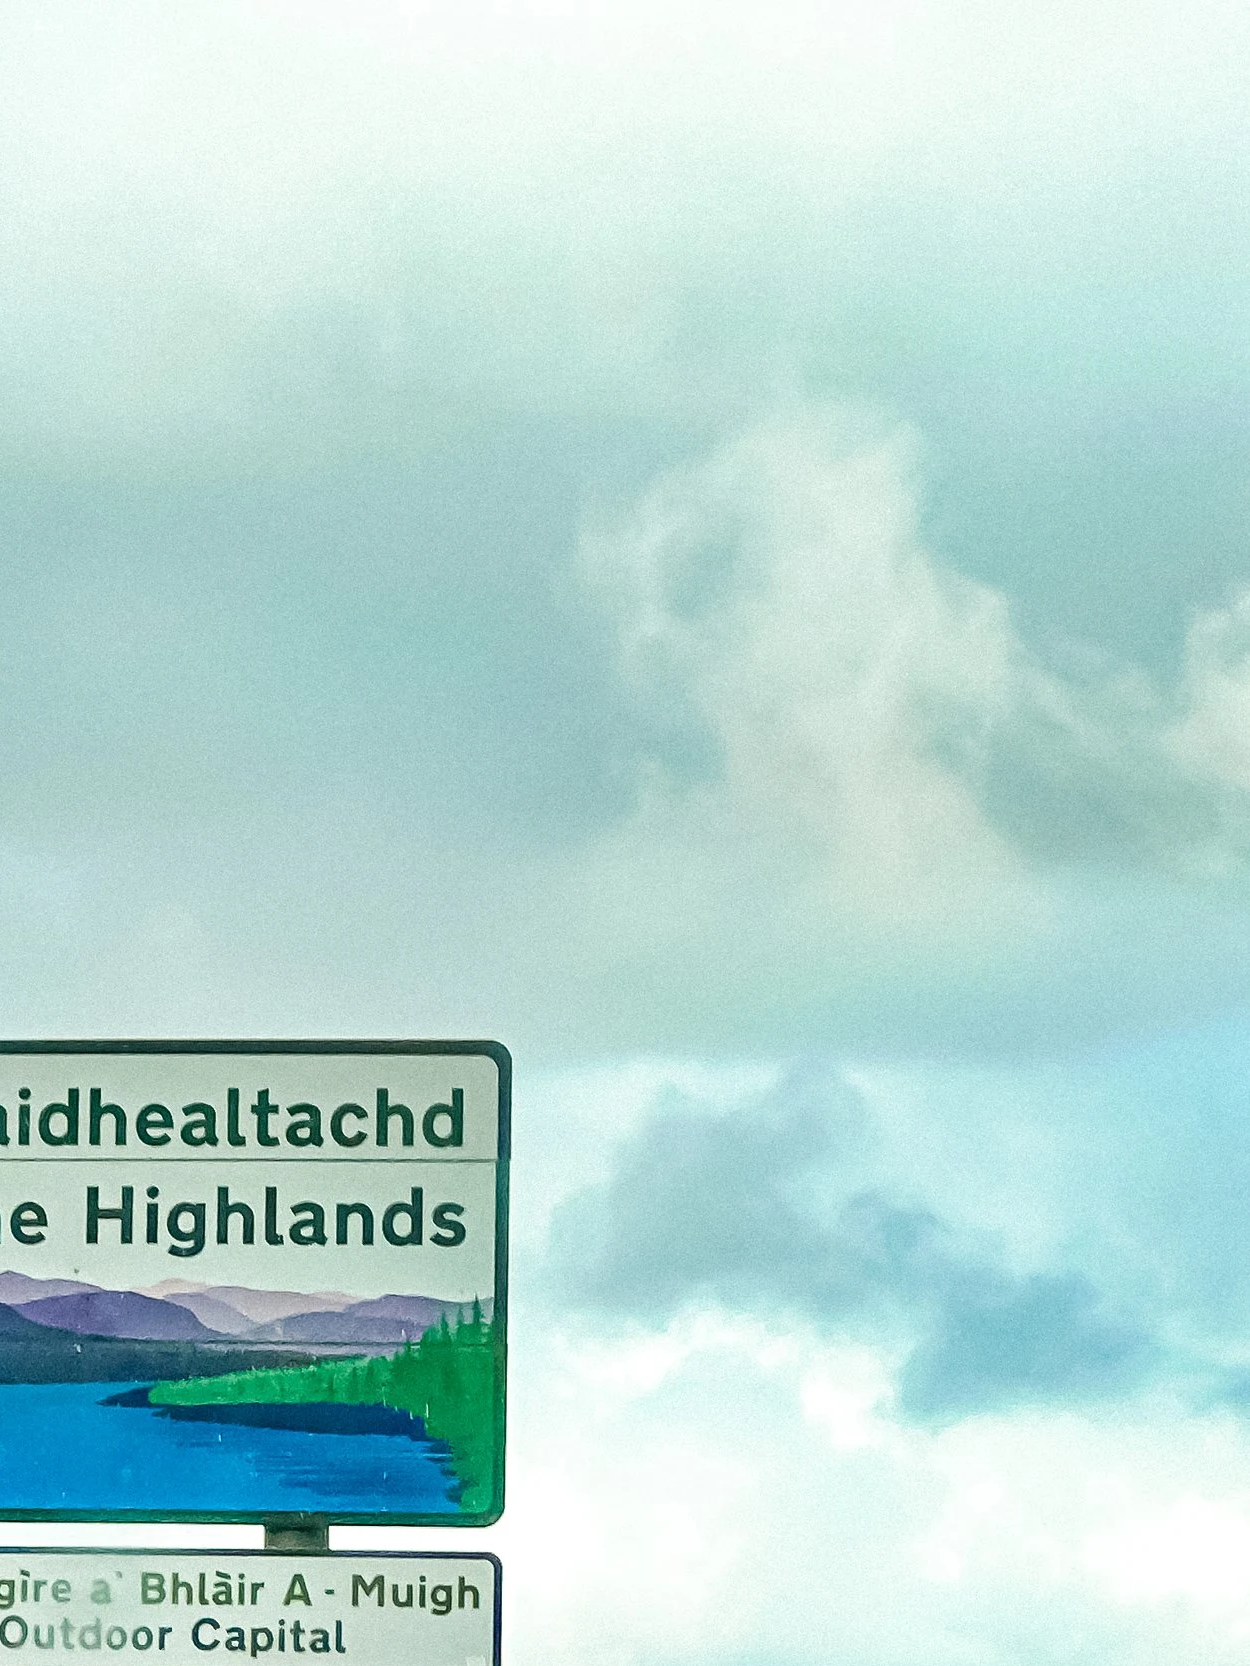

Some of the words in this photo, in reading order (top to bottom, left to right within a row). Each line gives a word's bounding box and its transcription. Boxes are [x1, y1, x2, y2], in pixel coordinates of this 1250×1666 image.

[85, 1185, 467, 1258] Highlands
[141, 1570, 265, 1606] Bhlàir
[282, 1573, 313, 1606] A
[352, 1574, 479, 1616] Muigh
[191, 1617, 347, 1659] Capital
